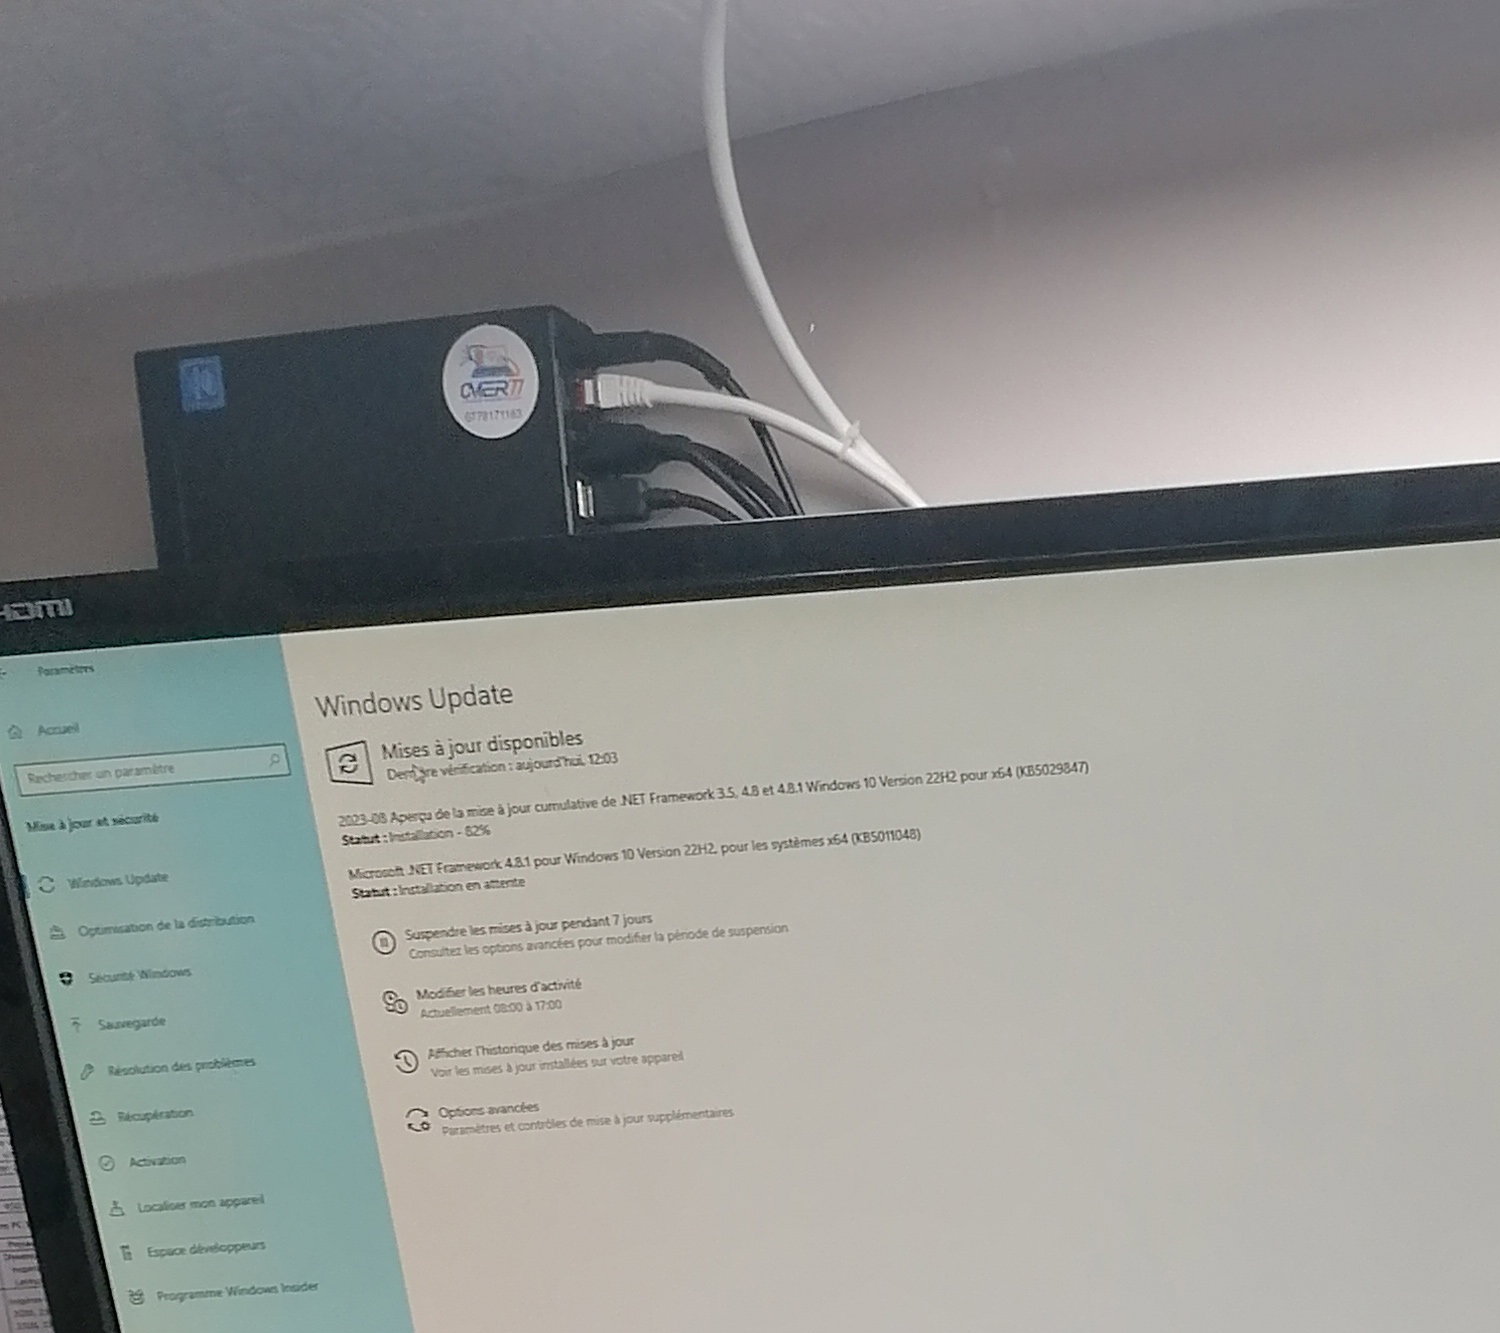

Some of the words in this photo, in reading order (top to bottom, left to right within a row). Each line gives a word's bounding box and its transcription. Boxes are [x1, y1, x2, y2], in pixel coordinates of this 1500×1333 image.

[315, 690, 423, 719] Windows
[428, 683, 515, 717] Update
[37, 722, 80, 737] Accueil
[381, 741, 430, 761] Mises
[434, 740, 446, 757] à
[447, 737, 482, 760] jour
[487, 730, 584, 757] disponibles
[440, 759, 506, 778] vérification
[588, 751, 619, 766] 12:03
[435, 807, 451, 821] de
[507, 801, 532, 818] jour
[534, 797, 599, 815] cumulative
[601, 795, 618, 809] de
[649, 787, 716, 806] Framework
[805, 777, 861, 794] Windows
[863, 776, 877, 790] 10
[878, 773, 924, 789] Version
[926, 771, 958, 786] 22H2
[960, 770, 990, 786] pour
[991, 767, 1013, 781] x64
[341, 832, 381, 848] Statut
[389, 826, 454, 844] Installation
[437, 858, 502, 876] Framework
[534, 855, 562, 872] pour
[563, 849, 619, 867] Windows
[124, 871, 169, 888] Update
[398, 879, 463, 898] Installation
[465, 879, 482, 892] en
[405, 924, 466, 945] Suspendre
[468, 922, 487, 938] les
[489, 920, 522, 936] mises
[534, 917, 559, 936] jour
[561, 913, 610, 933] pendant
[621, 911, 654, 931] jours
[437, 1103, 485, 1121] Options
[485, 1100, 540, 1117] avancées
